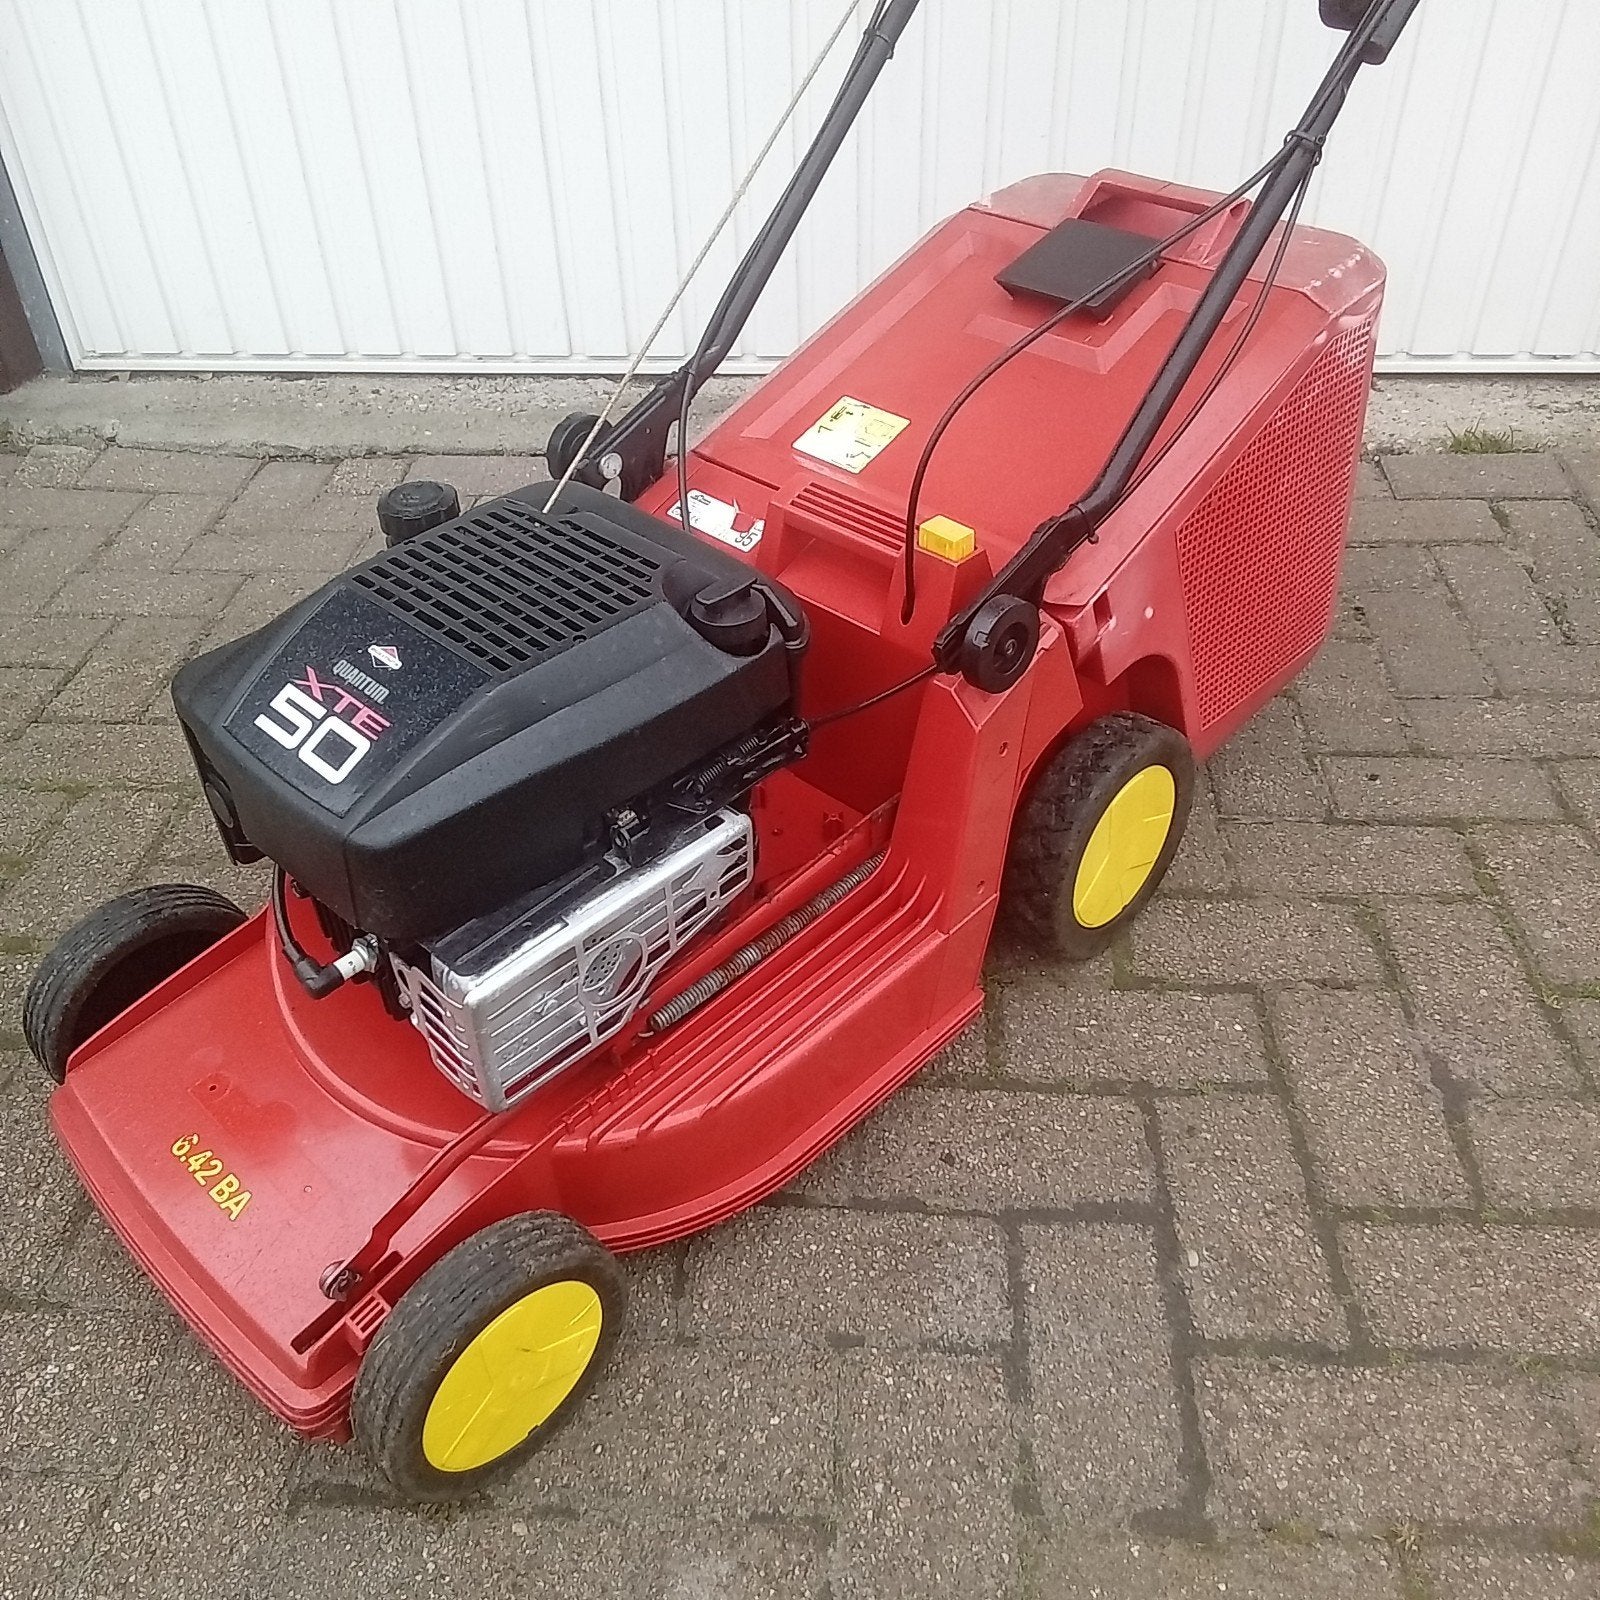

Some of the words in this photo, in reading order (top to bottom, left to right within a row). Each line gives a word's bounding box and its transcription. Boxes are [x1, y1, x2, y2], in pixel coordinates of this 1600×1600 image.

[290, 664, 392, 741] XTE
[332, 659, 390, 705] QUANTUM
[253, 682, 372, 785] 50
[170, 1133, 224, 1187] 6.42
[208, 1172, 252, 1221] BA
